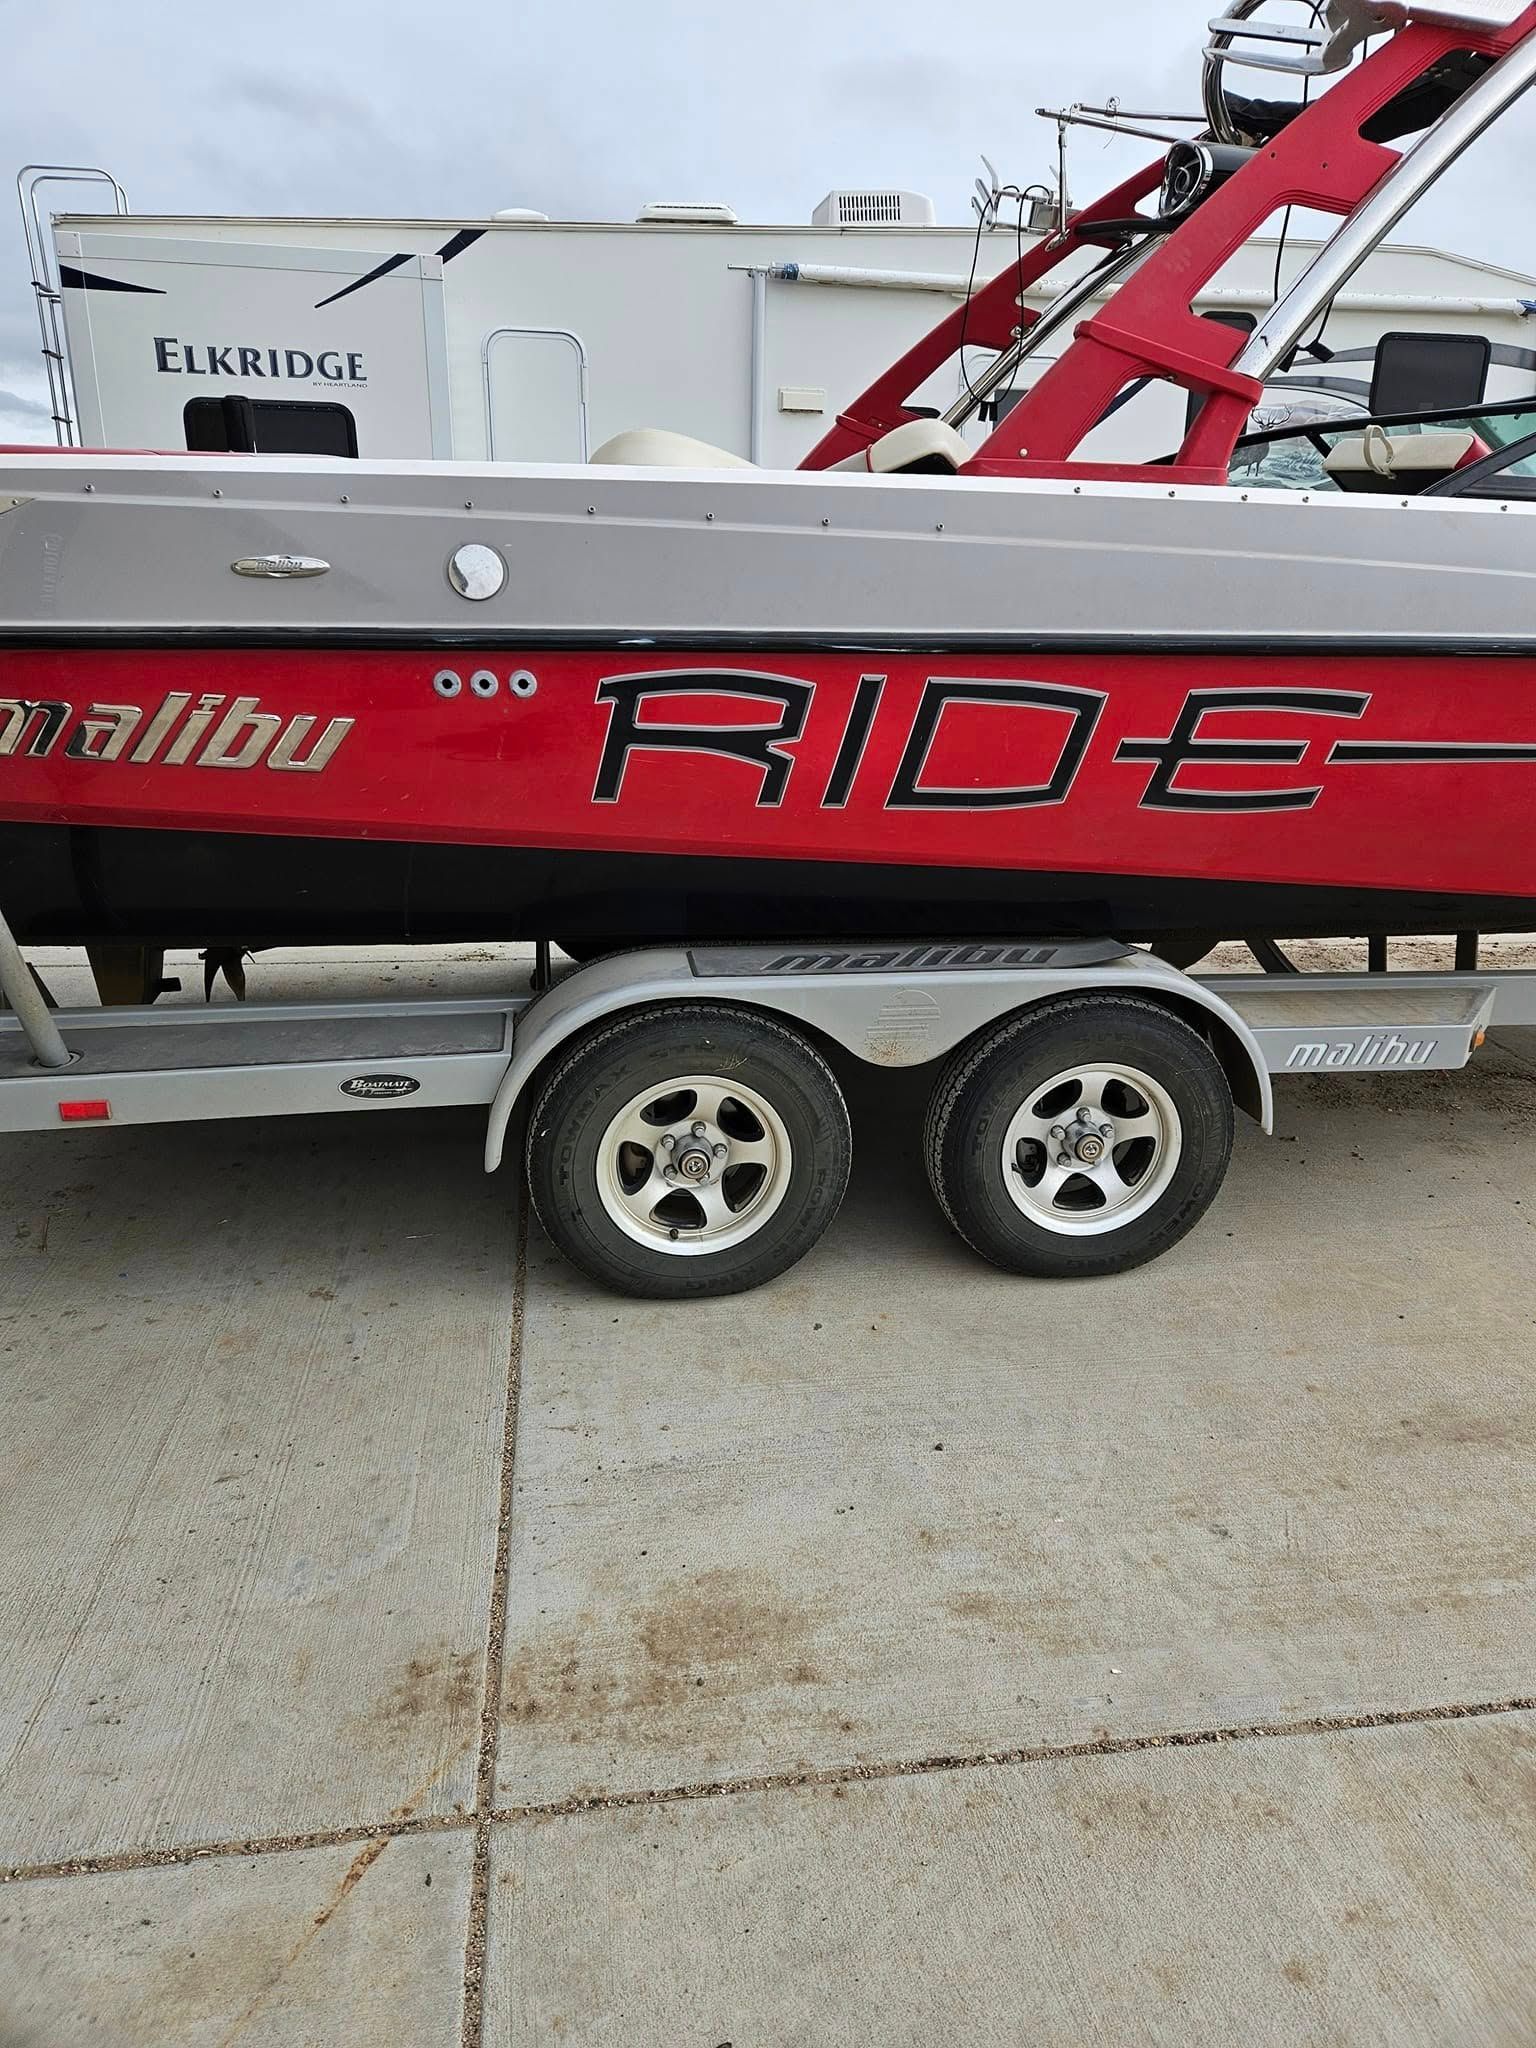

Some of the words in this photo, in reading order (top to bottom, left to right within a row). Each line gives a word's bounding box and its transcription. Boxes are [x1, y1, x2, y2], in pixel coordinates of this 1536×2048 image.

[153, 337, 368, 381] ELKRIDGE
[0, 690, 356, 773] malibu
[592, 668, 1373, 813] RIDE
[761, 944, 1059, 971] malibu
[1285, 1033, 1439, 1068] malibu
